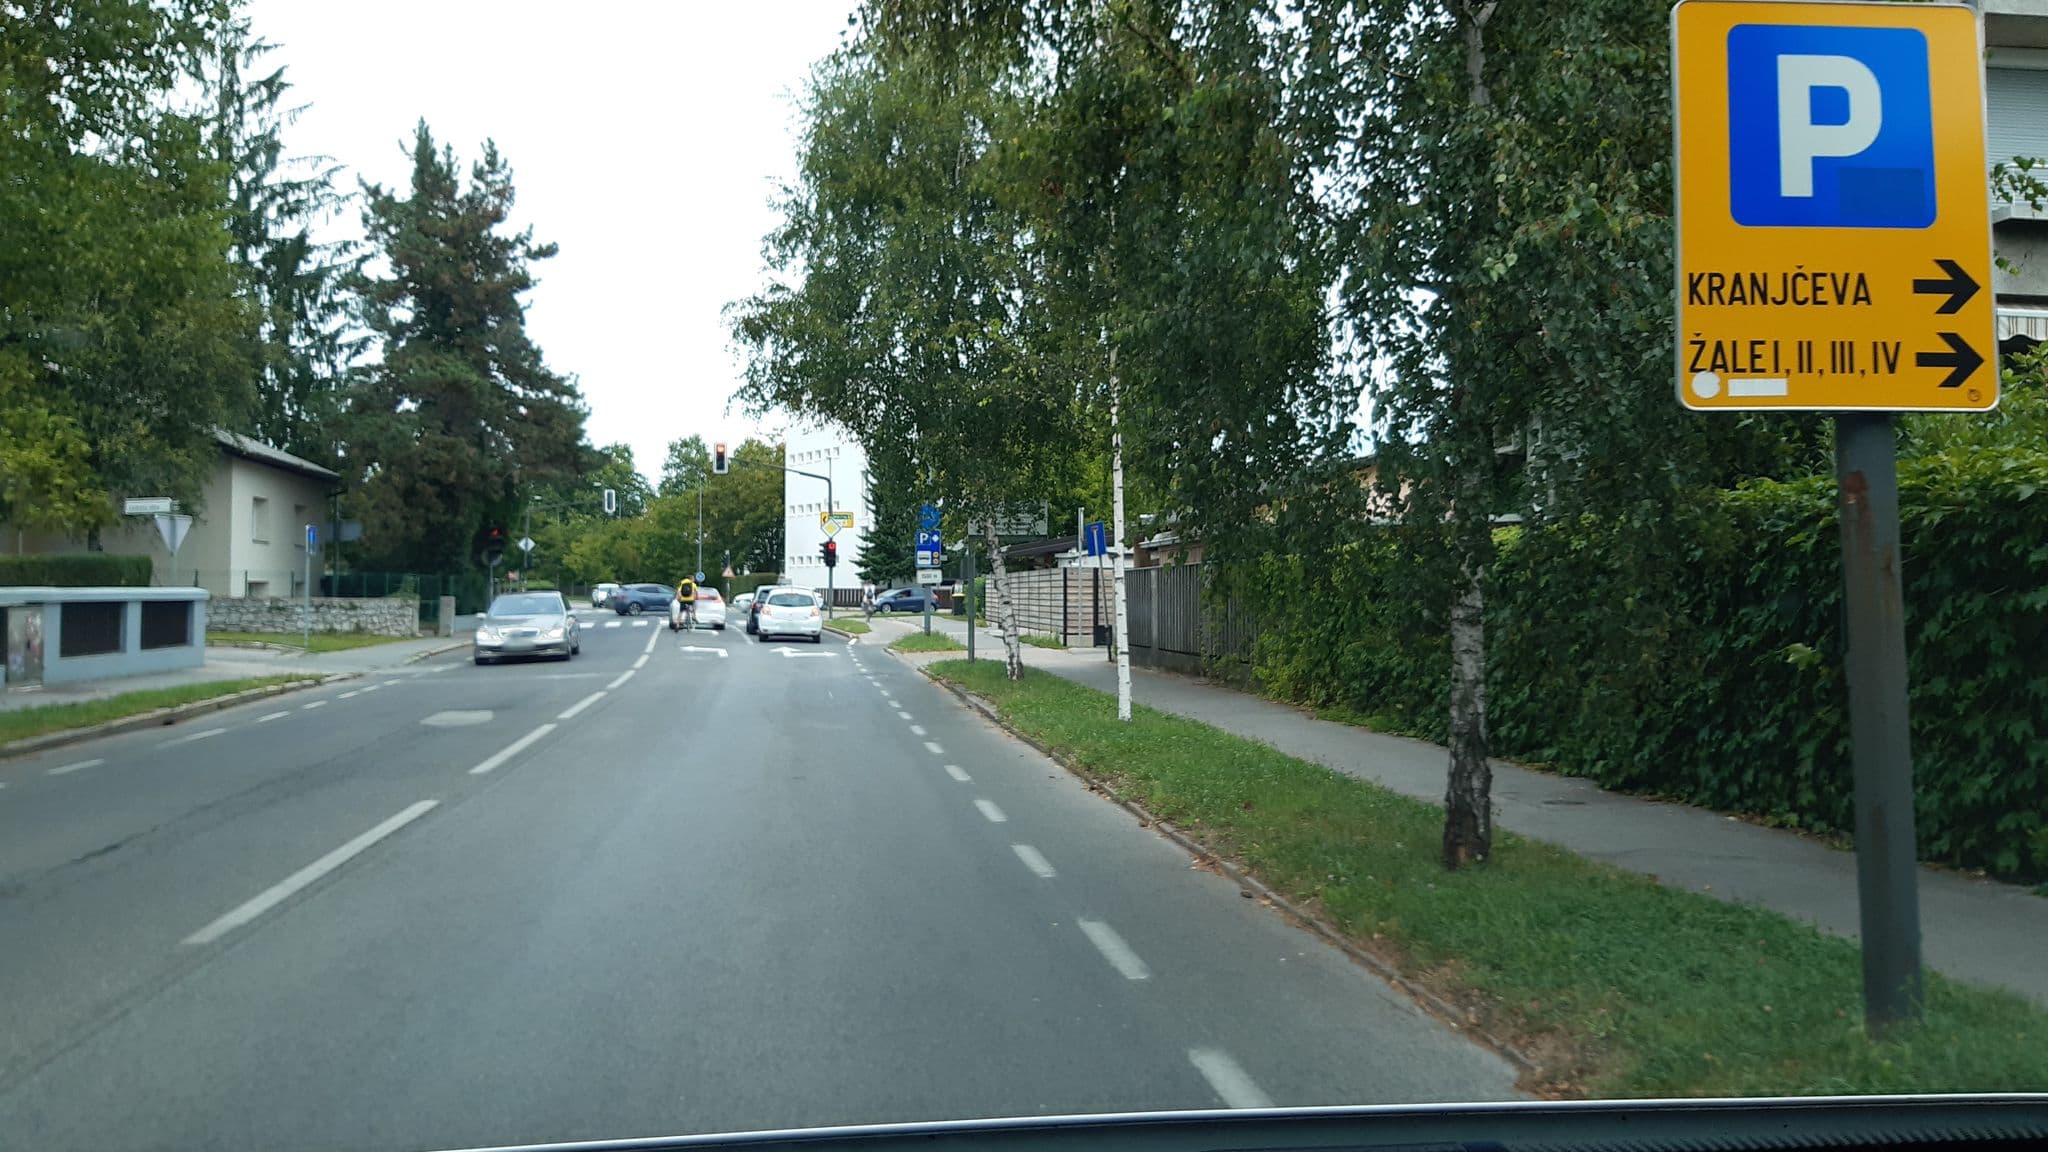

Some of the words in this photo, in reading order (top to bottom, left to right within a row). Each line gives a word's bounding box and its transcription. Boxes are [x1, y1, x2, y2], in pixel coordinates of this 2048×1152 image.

[1777, 54, 1882, 197] P
[1688, 265, 1872, 305] KRANJČEVA
[1688, 332, 1766, 374] ŽALE
[1872, 341, 1901, 374] IV
[919, 532, 929, 545] P
